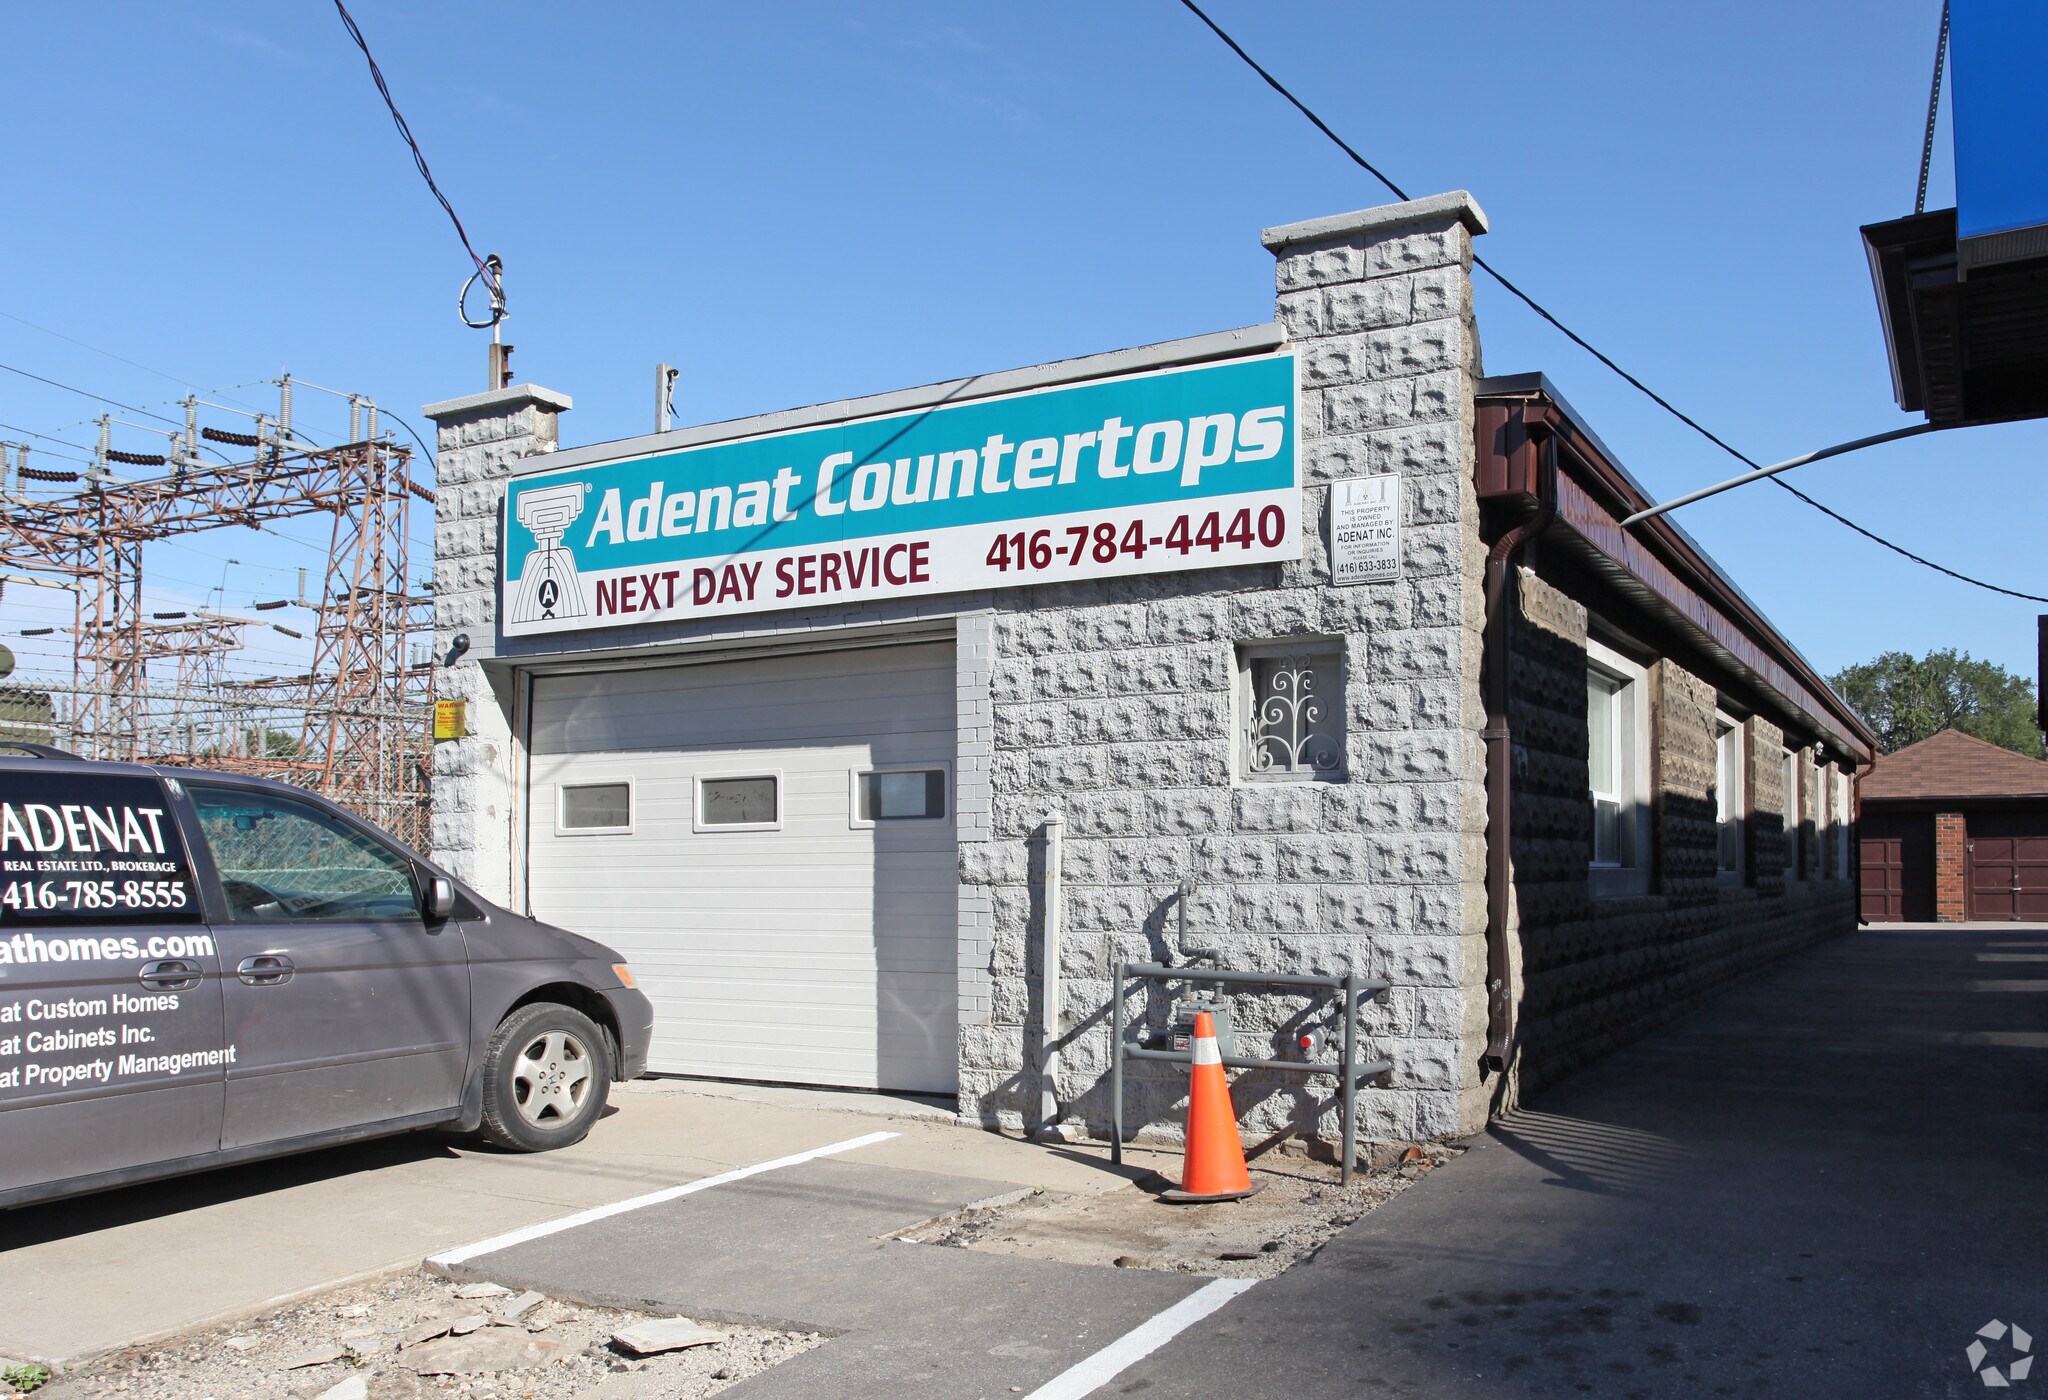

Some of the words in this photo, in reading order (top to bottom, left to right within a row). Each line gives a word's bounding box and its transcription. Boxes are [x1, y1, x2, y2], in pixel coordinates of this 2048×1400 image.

[585, 466, 802, 549] Adenat
[814, 405, 1286, 517] Countertops
[1356, 505, 1391, 514] PROPERTY
[1357, 513, 1382, 521] OWNED
[985, 504, 1286, 573] 416-784-4440
[1336, 529, 1374, 543] ADENAT
[1376, 527, 1395, 539] INC.
[1351, 520, 1383, 529] MANAGED
[1353, 541, 1390, 549] INFORMATION
[596, 571, 681, 617] NEXT
[692, 561, 763, 606] DAY
[775, 541, 930, 598] SERVICE
[1336, 562, 1357, 575] (416)
[1358, 558, 1397, 572] 633-3833
[1, 802, 166, 854] ADENAT
[4, 860, 35, 871] REAL
[37, 860, 78, 872] ESTATE
[81, 861, 110, 873] LTD.,
[111, 861, 177, 872] BROKERAGE
[2, 880, 187, 909] 416-785-8555
[0, 933, 215, 964] athomes.com
[0, 1001, 22, 1023] at
[26, 997, 107, 1021] Custom
[112, 993, 179, 1014] Homes
[0, 1035, 21, 1055] at
[26, 1026, 117, 1053] Cabinets
[121, 1024, 156, 1045] Inc.
[0, 1066, 20, 1088] at
[25, 1059, 113, 1086] Property
[118, 1044, 236, 1076] Management
